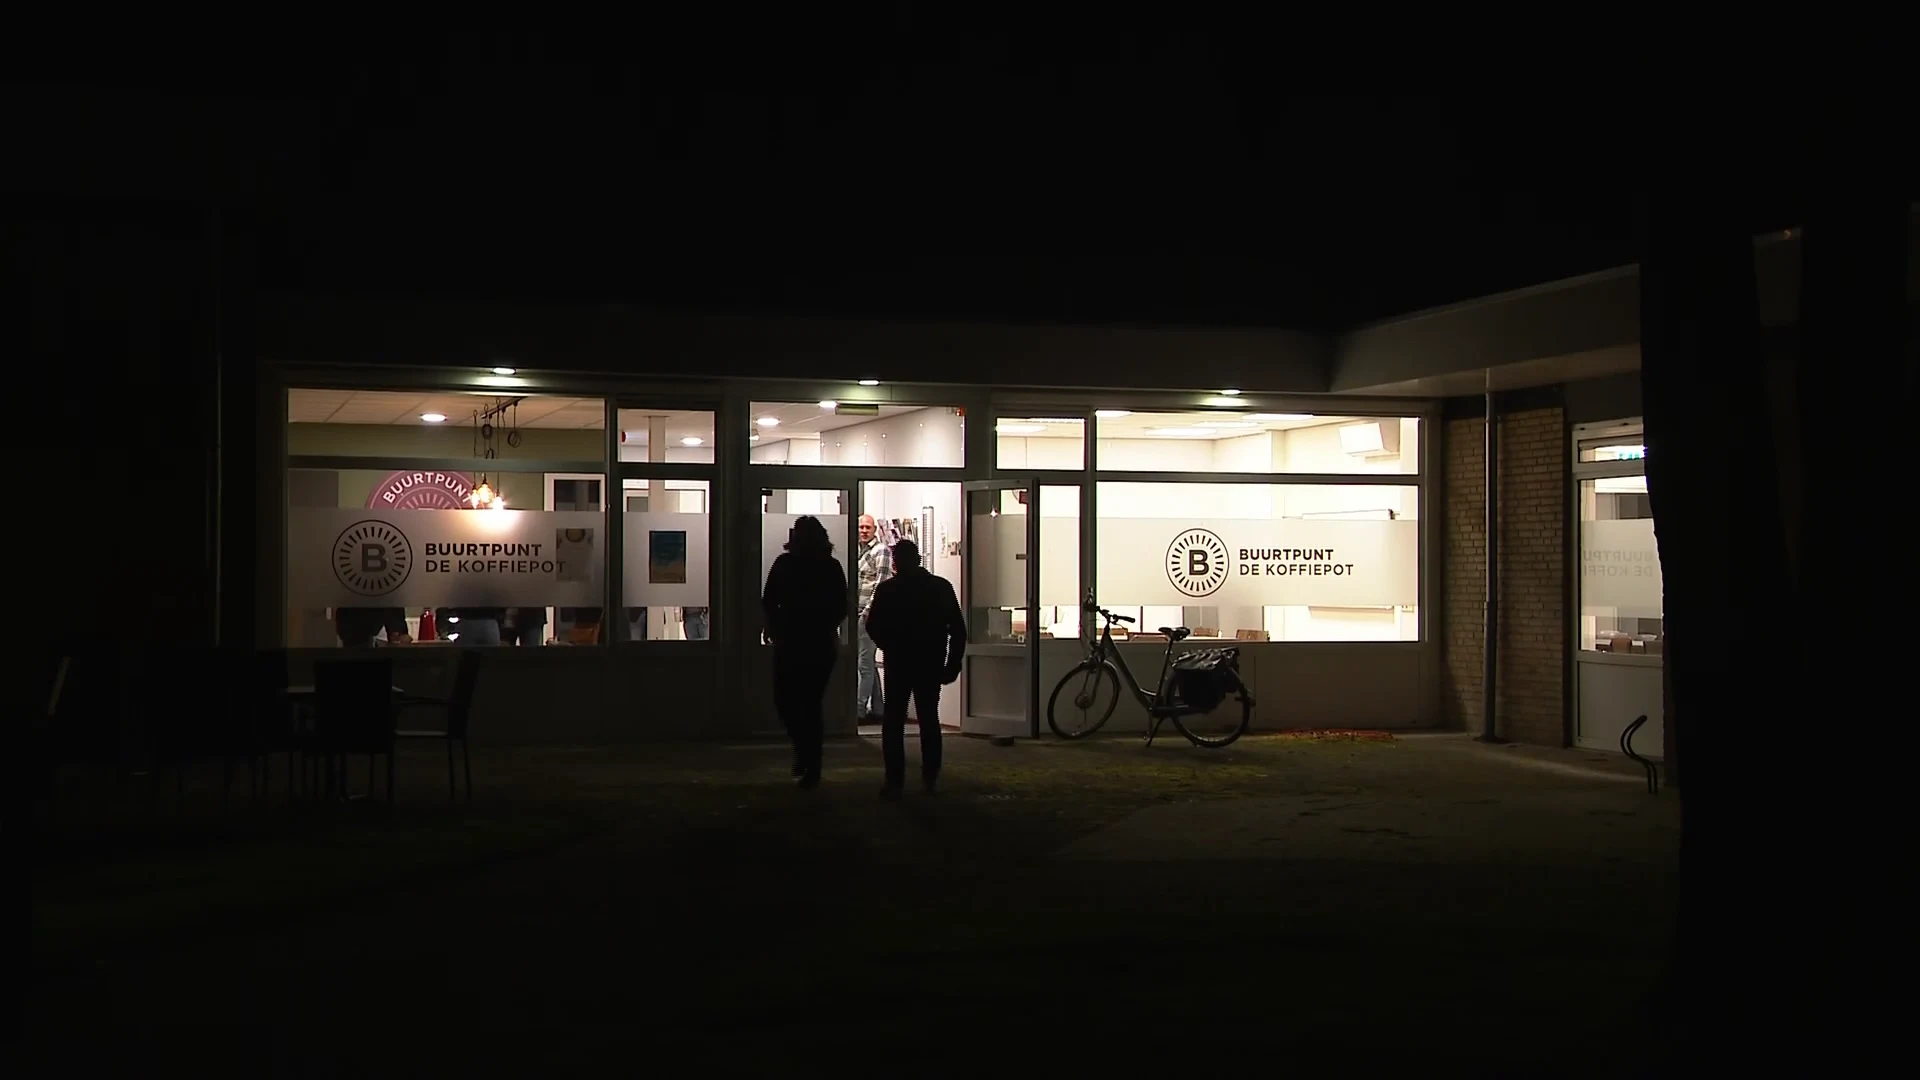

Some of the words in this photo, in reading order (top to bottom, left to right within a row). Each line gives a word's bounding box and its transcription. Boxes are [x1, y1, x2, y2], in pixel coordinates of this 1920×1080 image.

[383, 471, 473, 503] BUURTPUNT
[425, 543, 542, 556] BUURTPUNT
[1239, 549, 1334, 561] BUURTPUNT
[361, 543, 387, 573] B
[1188, 549, 1210, 576] B
[425, 560, 450, 573] DE
[458, 560, 567, 573] KOFFIEPOT
[1240, 563, 1260, 576] DE
[1266, 563, 1354, 576] KOFFIEPOT
